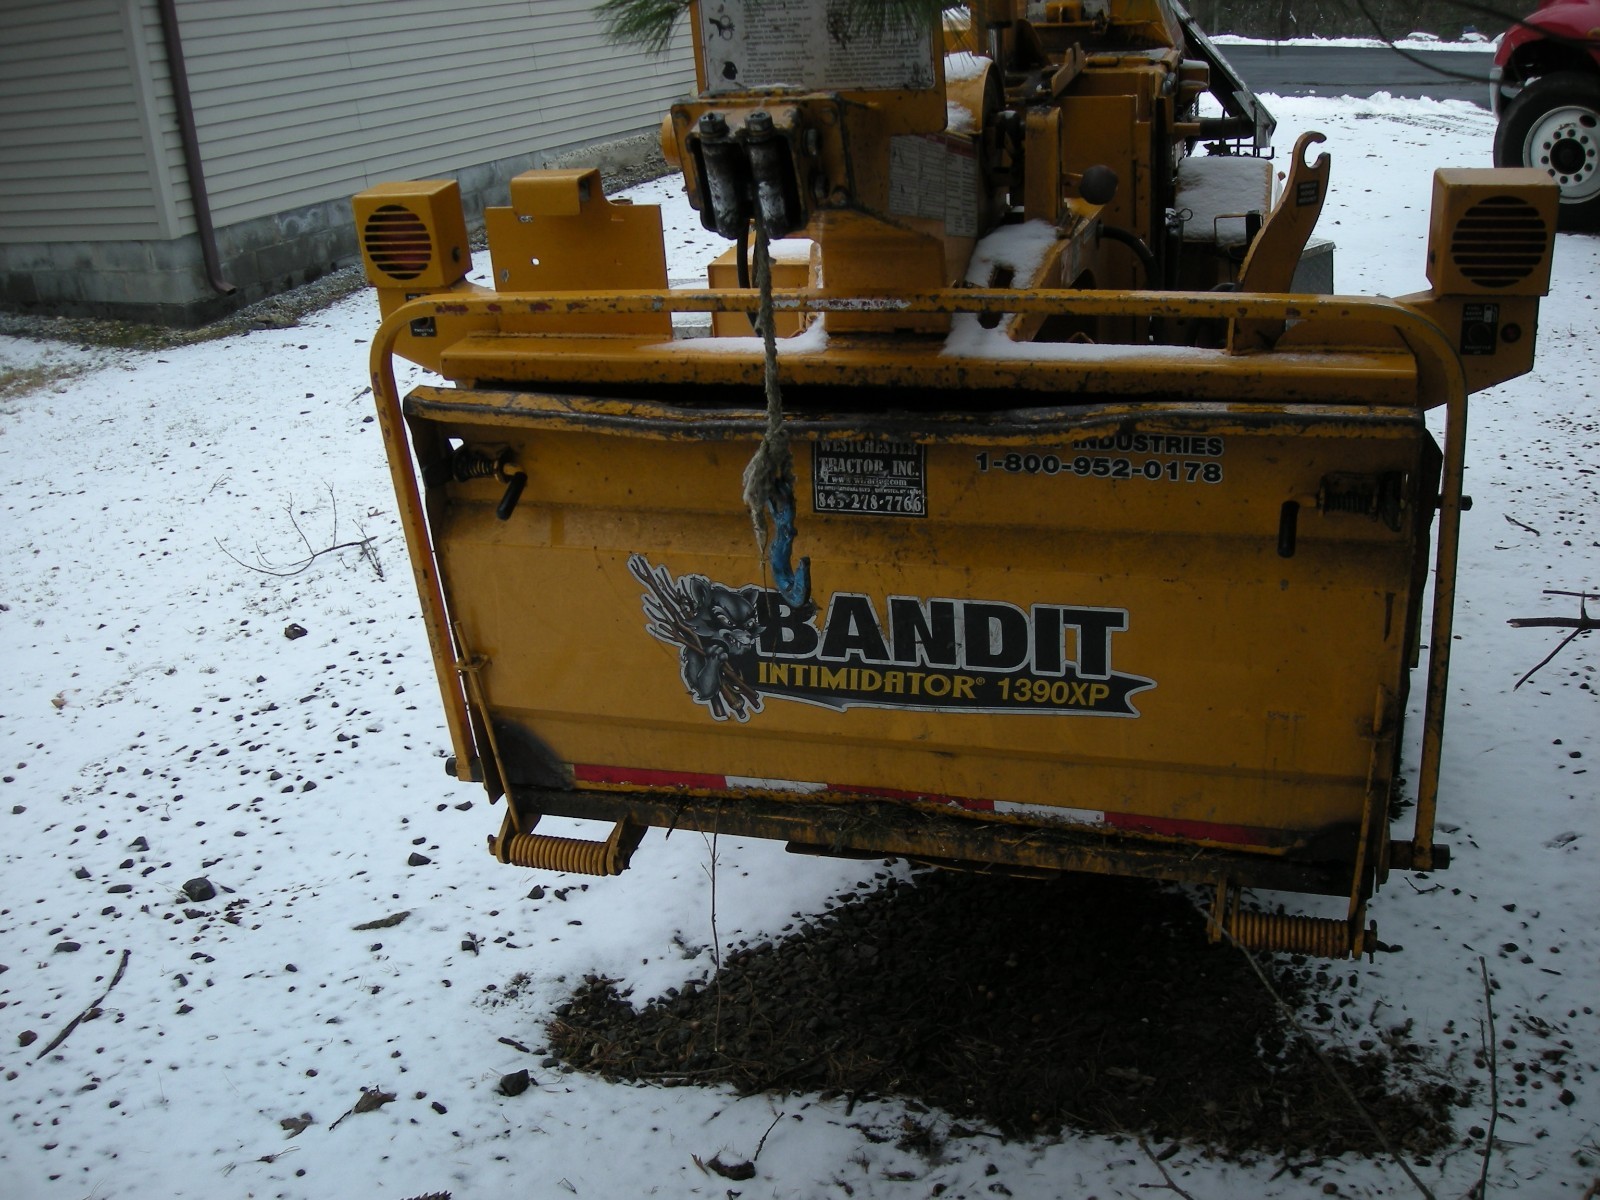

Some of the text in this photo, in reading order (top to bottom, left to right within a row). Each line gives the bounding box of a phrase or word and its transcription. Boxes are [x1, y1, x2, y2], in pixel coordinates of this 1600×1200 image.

[1073, 434, 1223, 456] INDUSTRIES
[893, 460, 920, 477] INC.
[975, 452, 1222, 483] 1-800-952-0178
[757, 592, 1127, 679] BANDIT
[997, 677, 1110, 707] 1390XP
